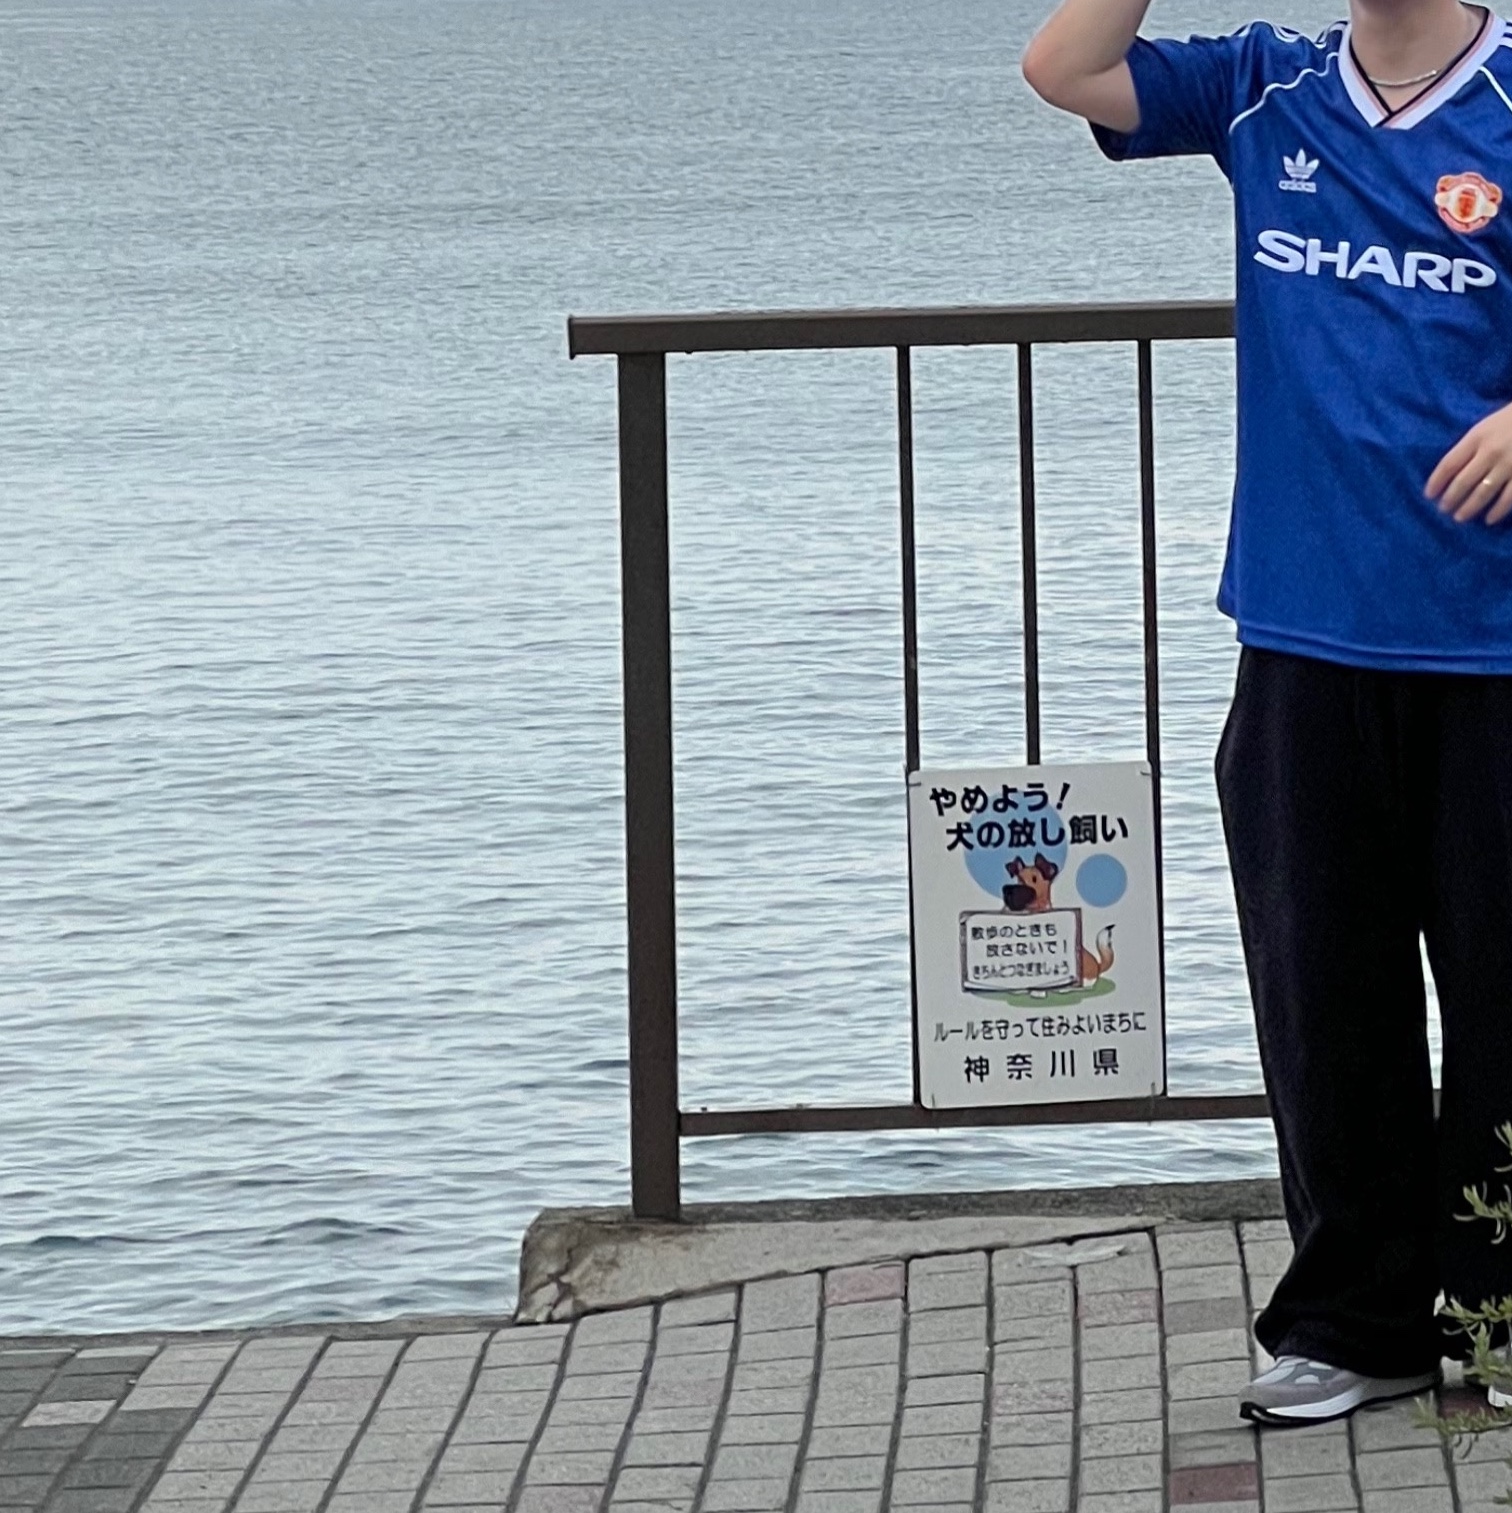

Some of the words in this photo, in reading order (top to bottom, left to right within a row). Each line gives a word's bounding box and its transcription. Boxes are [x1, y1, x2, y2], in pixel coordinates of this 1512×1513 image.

[1253, 229, 1497, 294] SHARP
[929, 782, 1071, 817] やめよう！
[945, 814, 1129, 851] 犬の放し飼い
[934, 1011, 1147, 1042] ルールを守って住みよいまちに
[964, 1048, 1120, 1084] 神奈川県
